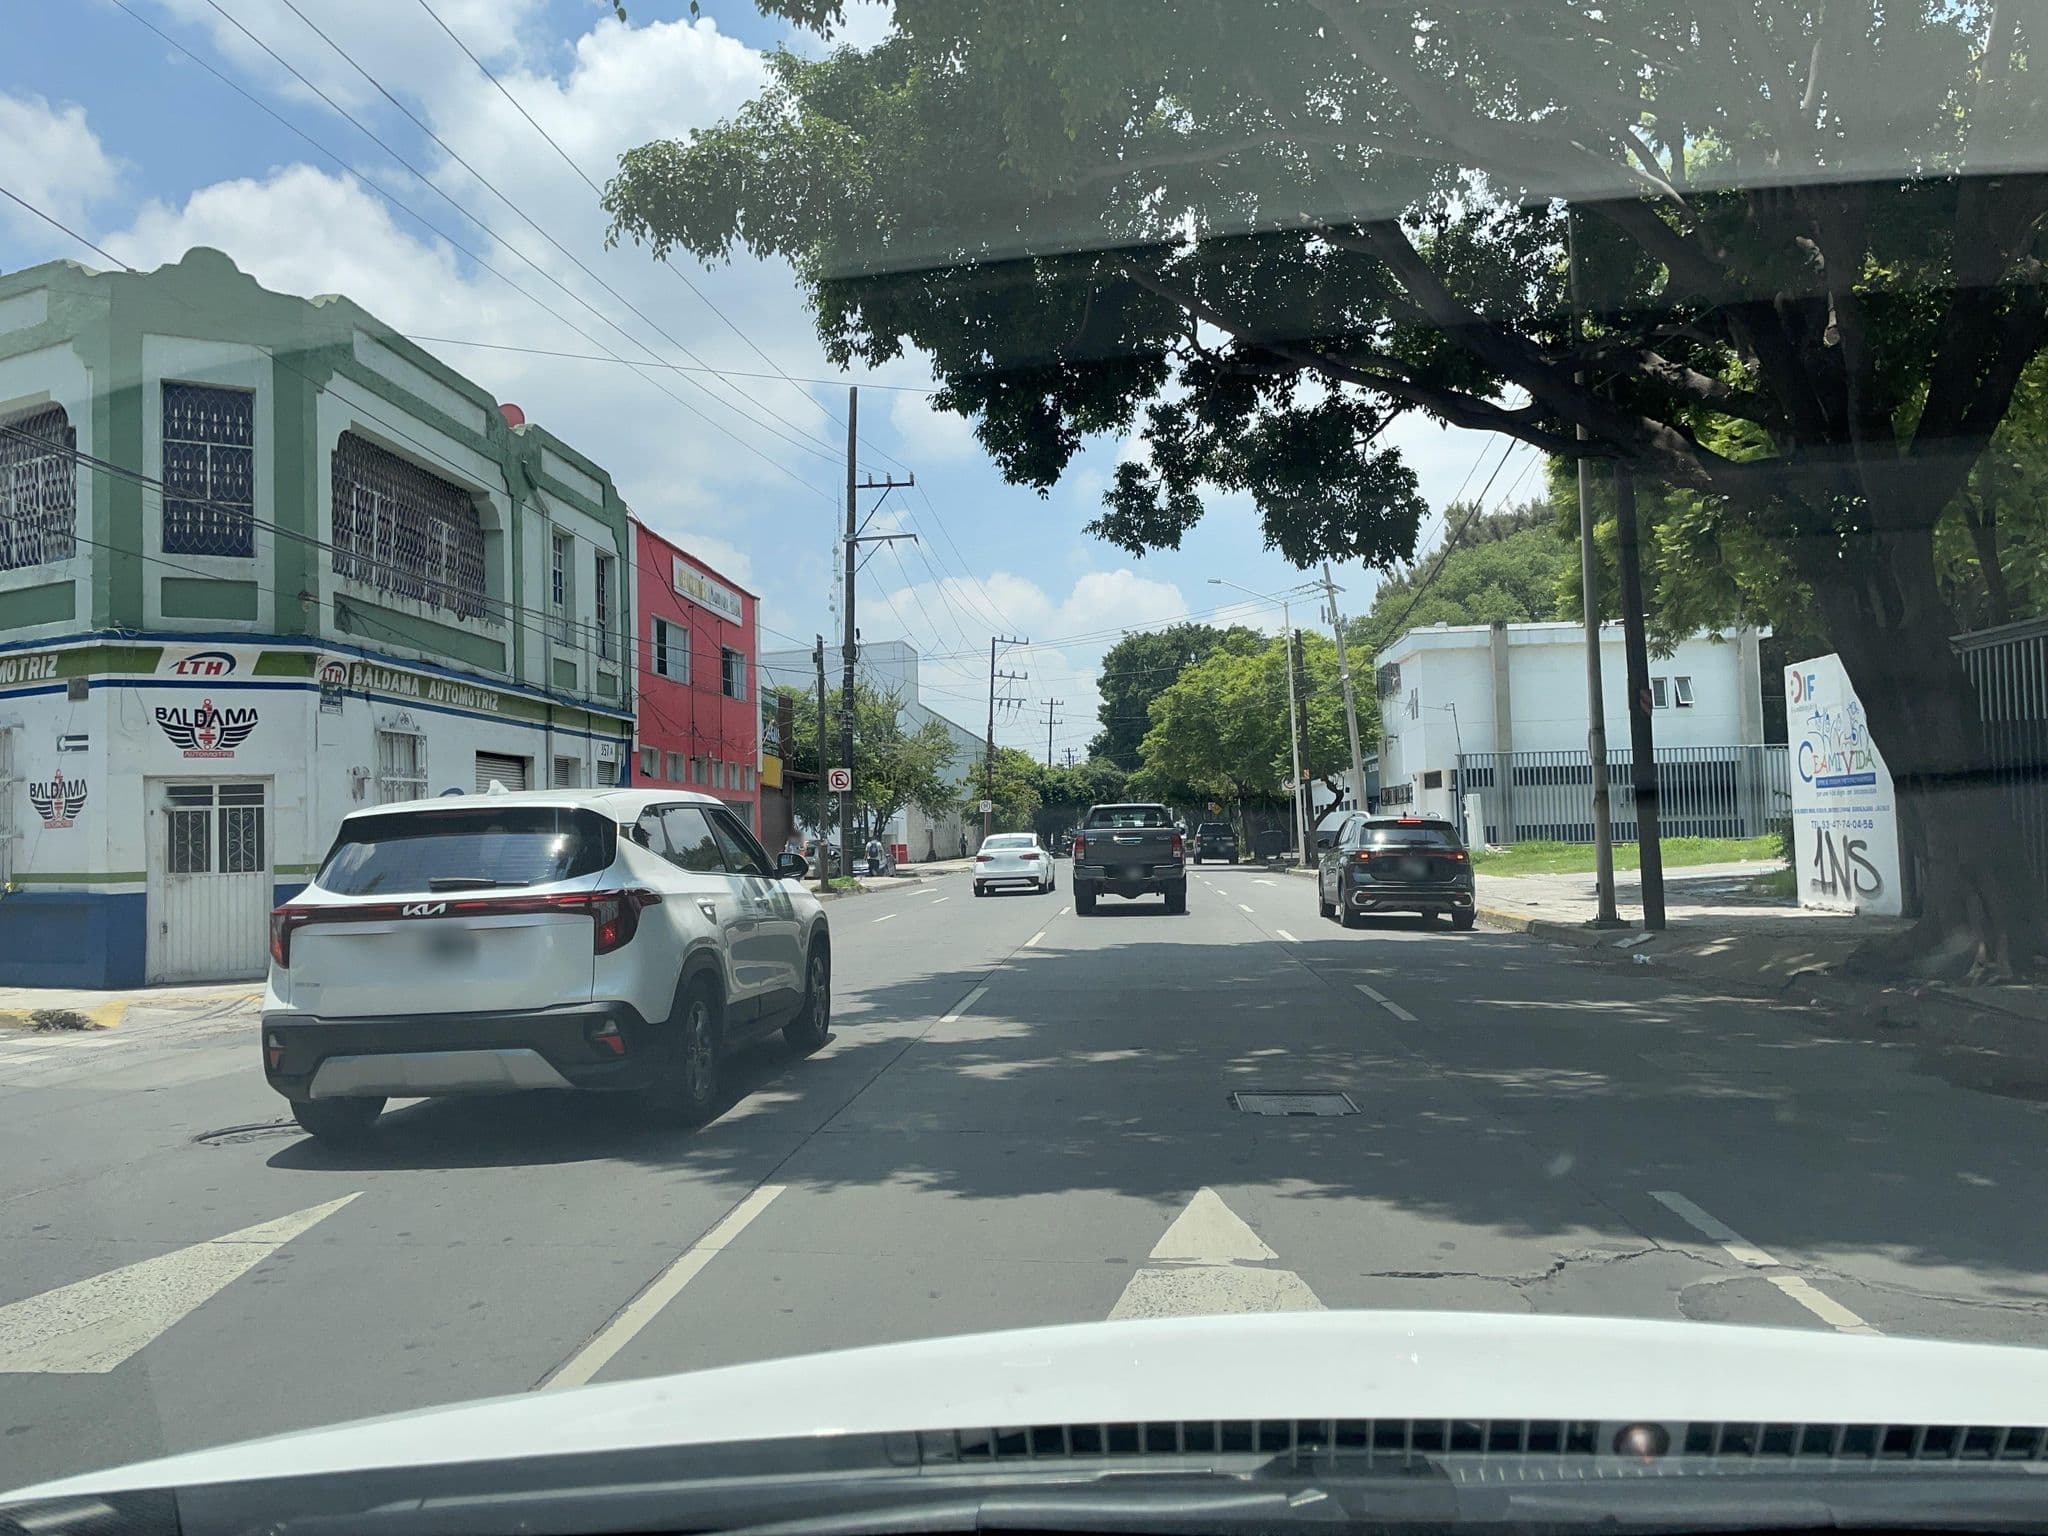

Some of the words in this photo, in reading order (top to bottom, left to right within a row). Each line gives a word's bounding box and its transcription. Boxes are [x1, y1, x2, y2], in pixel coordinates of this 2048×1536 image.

[176, 661, 223, 675] LTH
[322, 668, 343, 683] LTH
[353, 665, 420, 696] BALDAMA
[428, 680, 499, 711] AUTOMOTRIZ
[1791, 670, 1815, 704] DIF
[155, 707, 258, 728] BALDAMA
[30, 779, 88, 799] BALDAMA
[402, 902, 446, 916] KIA
